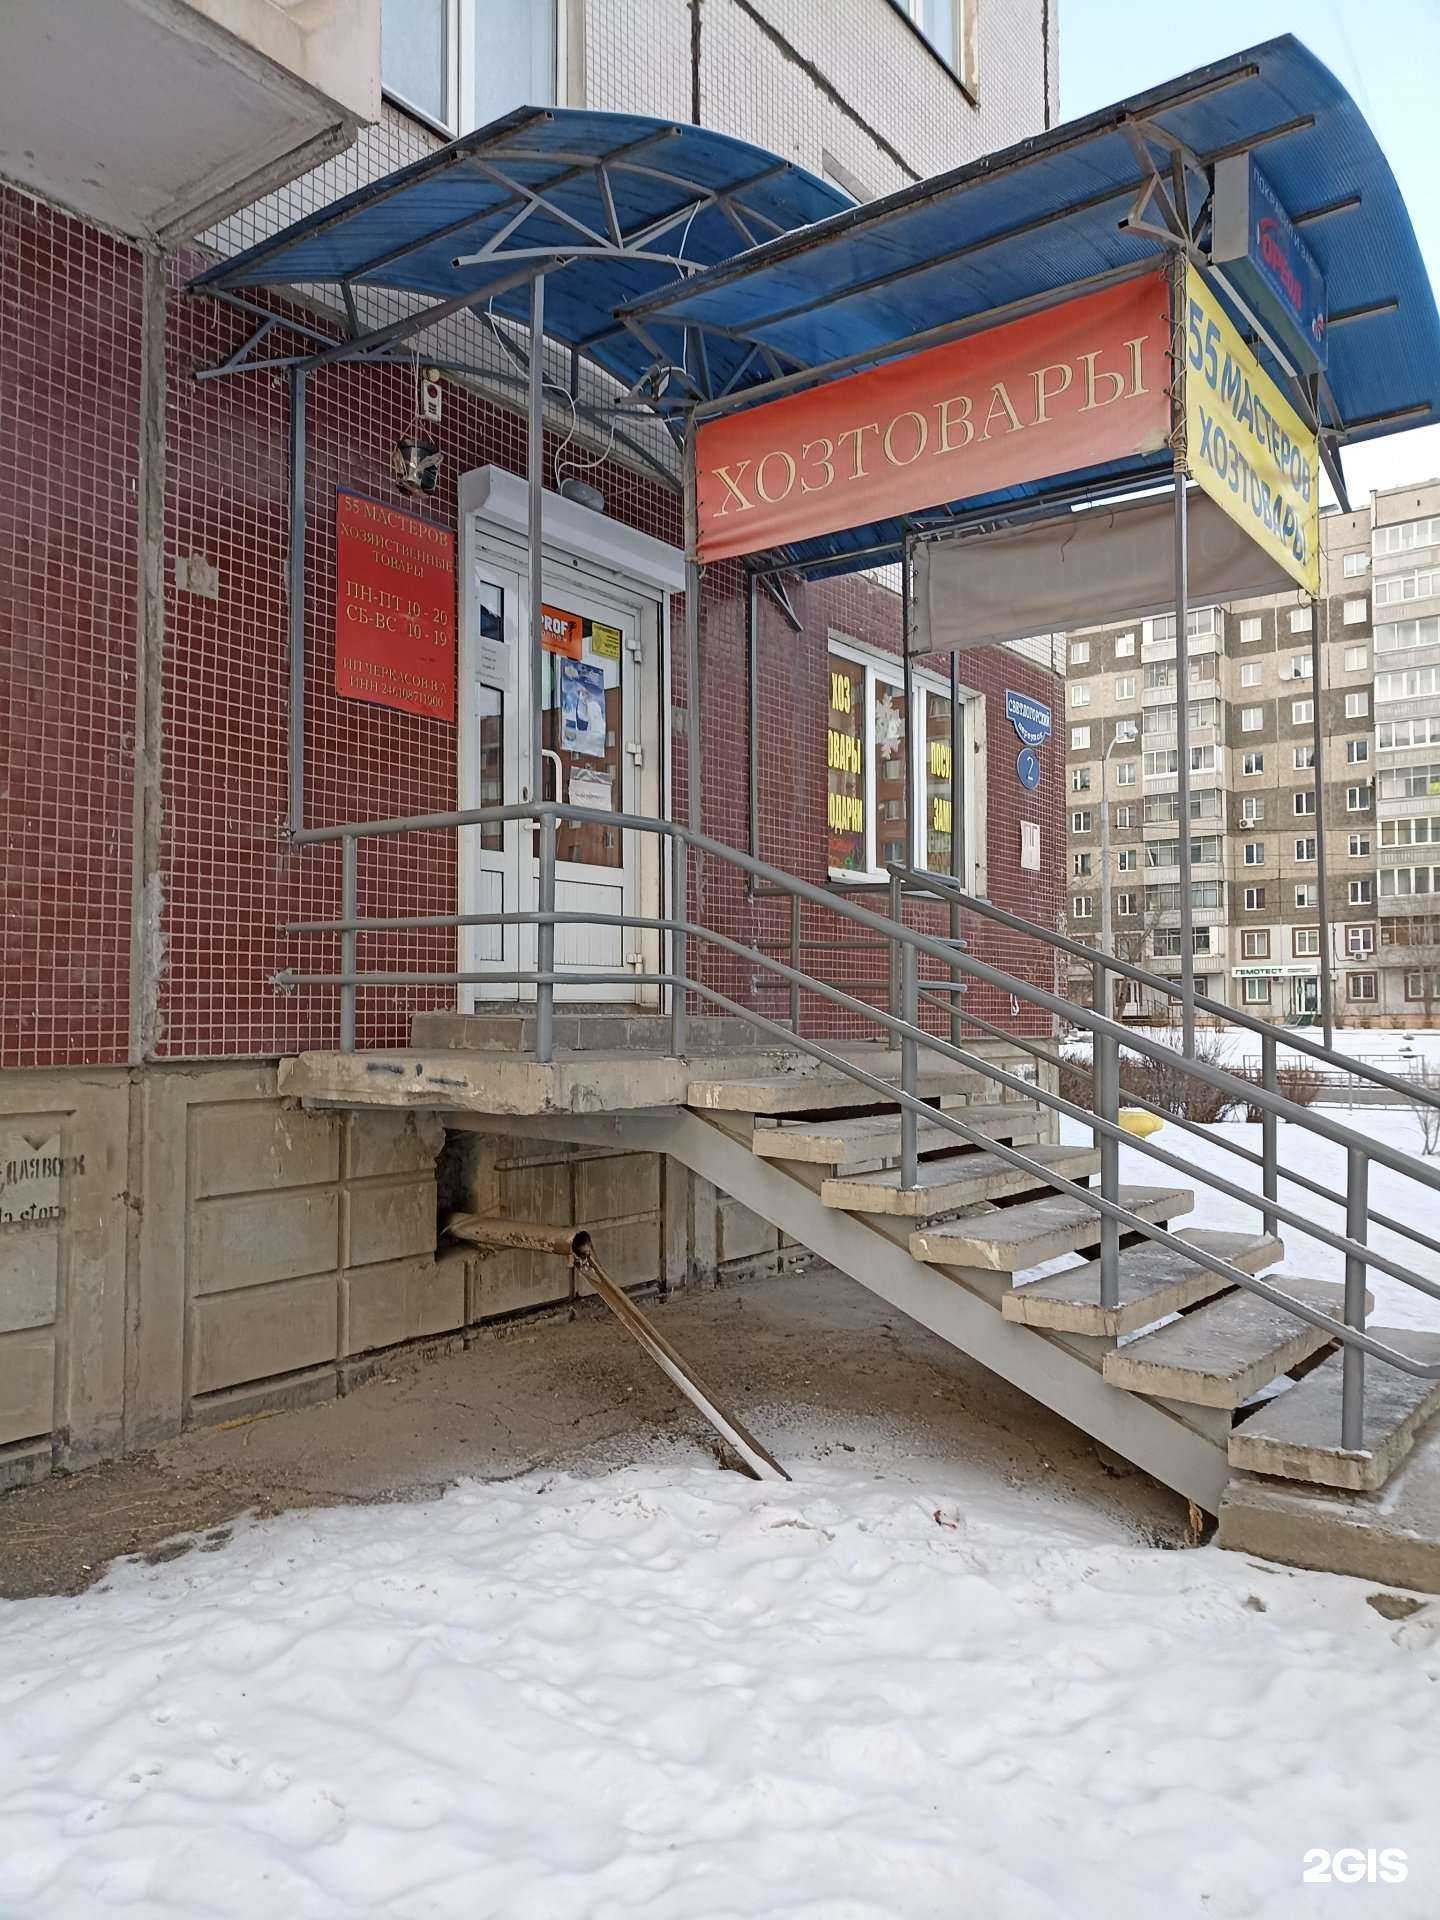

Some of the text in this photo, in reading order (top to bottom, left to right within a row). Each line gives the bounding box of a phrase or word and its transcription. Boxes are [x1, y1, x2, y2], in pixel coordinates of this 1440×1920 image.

[1188, 297, 1221, 391] 55
[1220, 351, 1311, 503] МАСТЕРОВ
[711, 335, 1151, 519] ХОЗТОВАРЫ
[1198, 404, 1308, 566] ХОЗТОВАРЫ
[344, 496, 449, 547] 55 МАСТЕРОВ
[372, 549, 424, 579] ТОВАРЫ
[345, 580, 402, 612] ПН-ПТ
[407, 600, 421, 618] 10
[433, 607, 448, 626] 20
[346, 603, 397, 633] СБ-ВС
[408, 623, 422, 640] 10
[434, 629, 447, 647] 19
[831, 672, 851, 715] ХОЗ
[930, 741, 952, 785] ПОСУ
[1026, 755, 1034, 781] 2
[933, 796, 952, 833] ЗАМ
